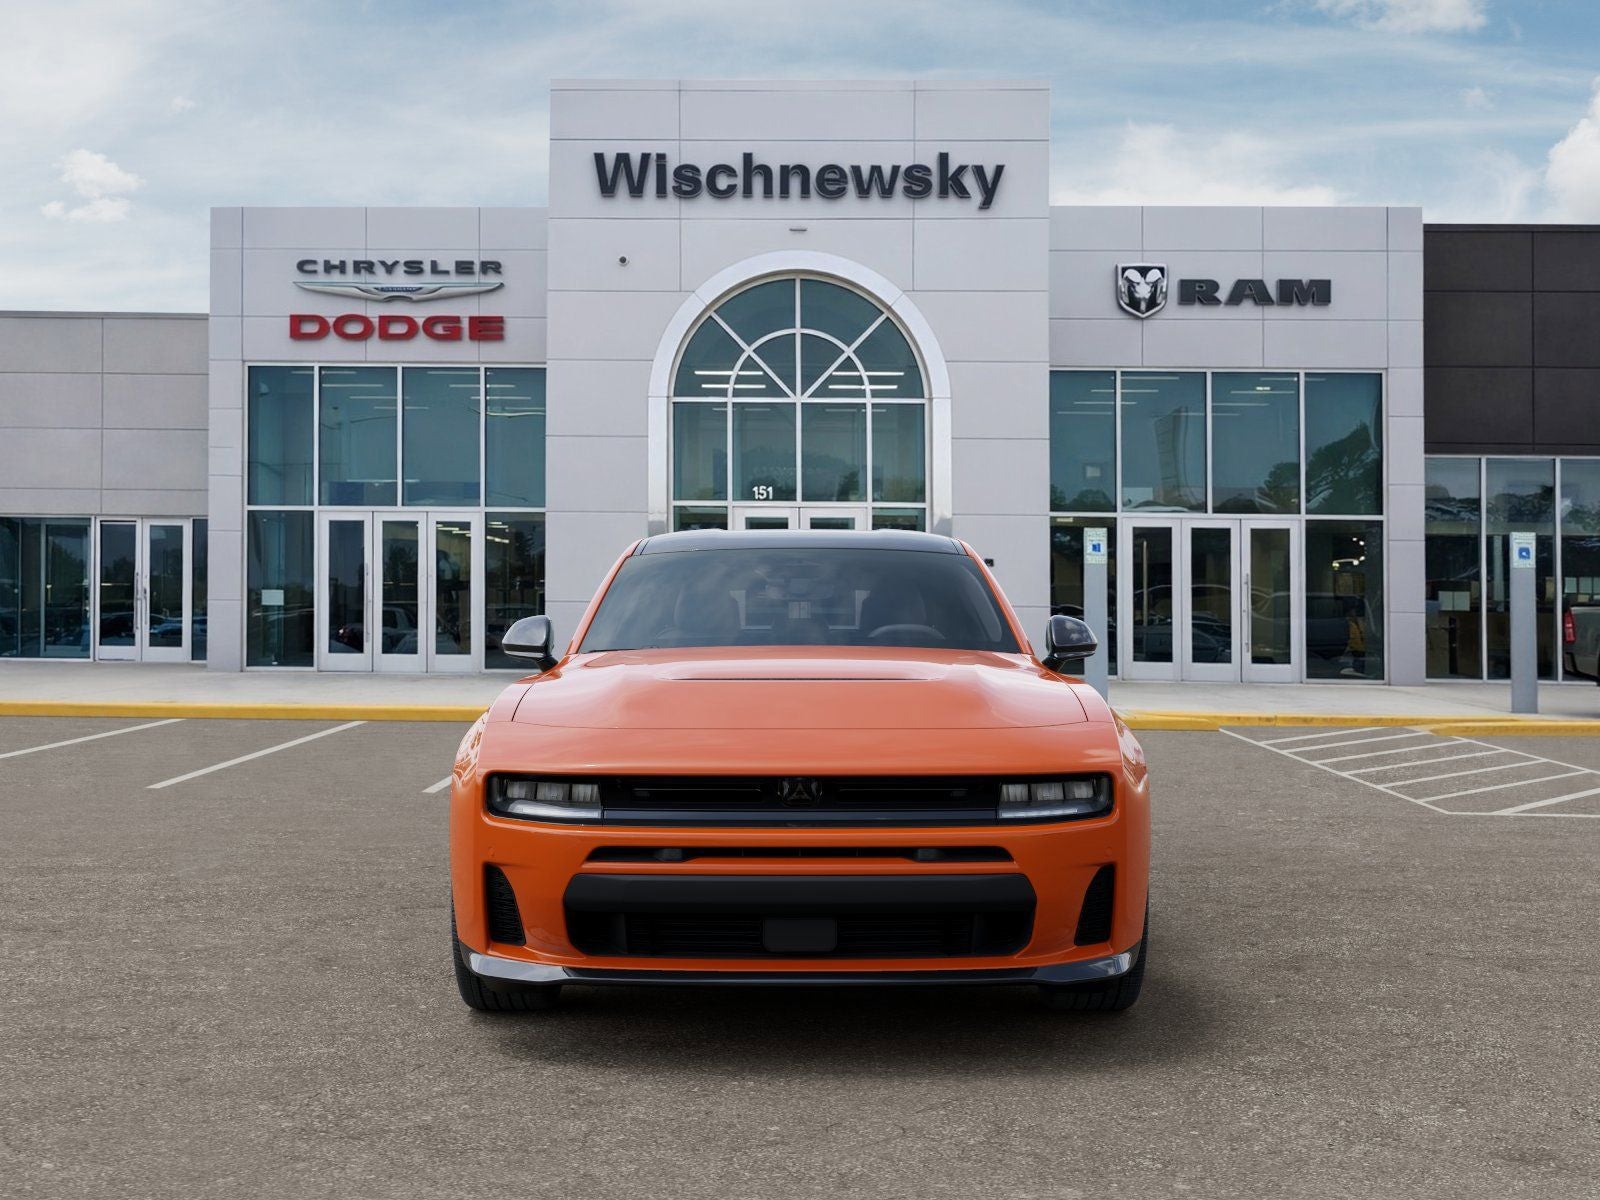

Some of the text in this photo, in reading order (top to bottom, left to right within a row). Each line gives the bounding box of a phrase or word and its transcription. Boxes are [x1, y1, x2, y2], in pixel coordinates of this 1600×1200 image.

[593, 151, 1005, 211] Wischnewsky
[296, 259, 503, 275] CHRYSLER
[1177, 278, 1332, 306] RAM
[289, 314, 505, 341] DODGE
[752, 485, 773, 500] 151
